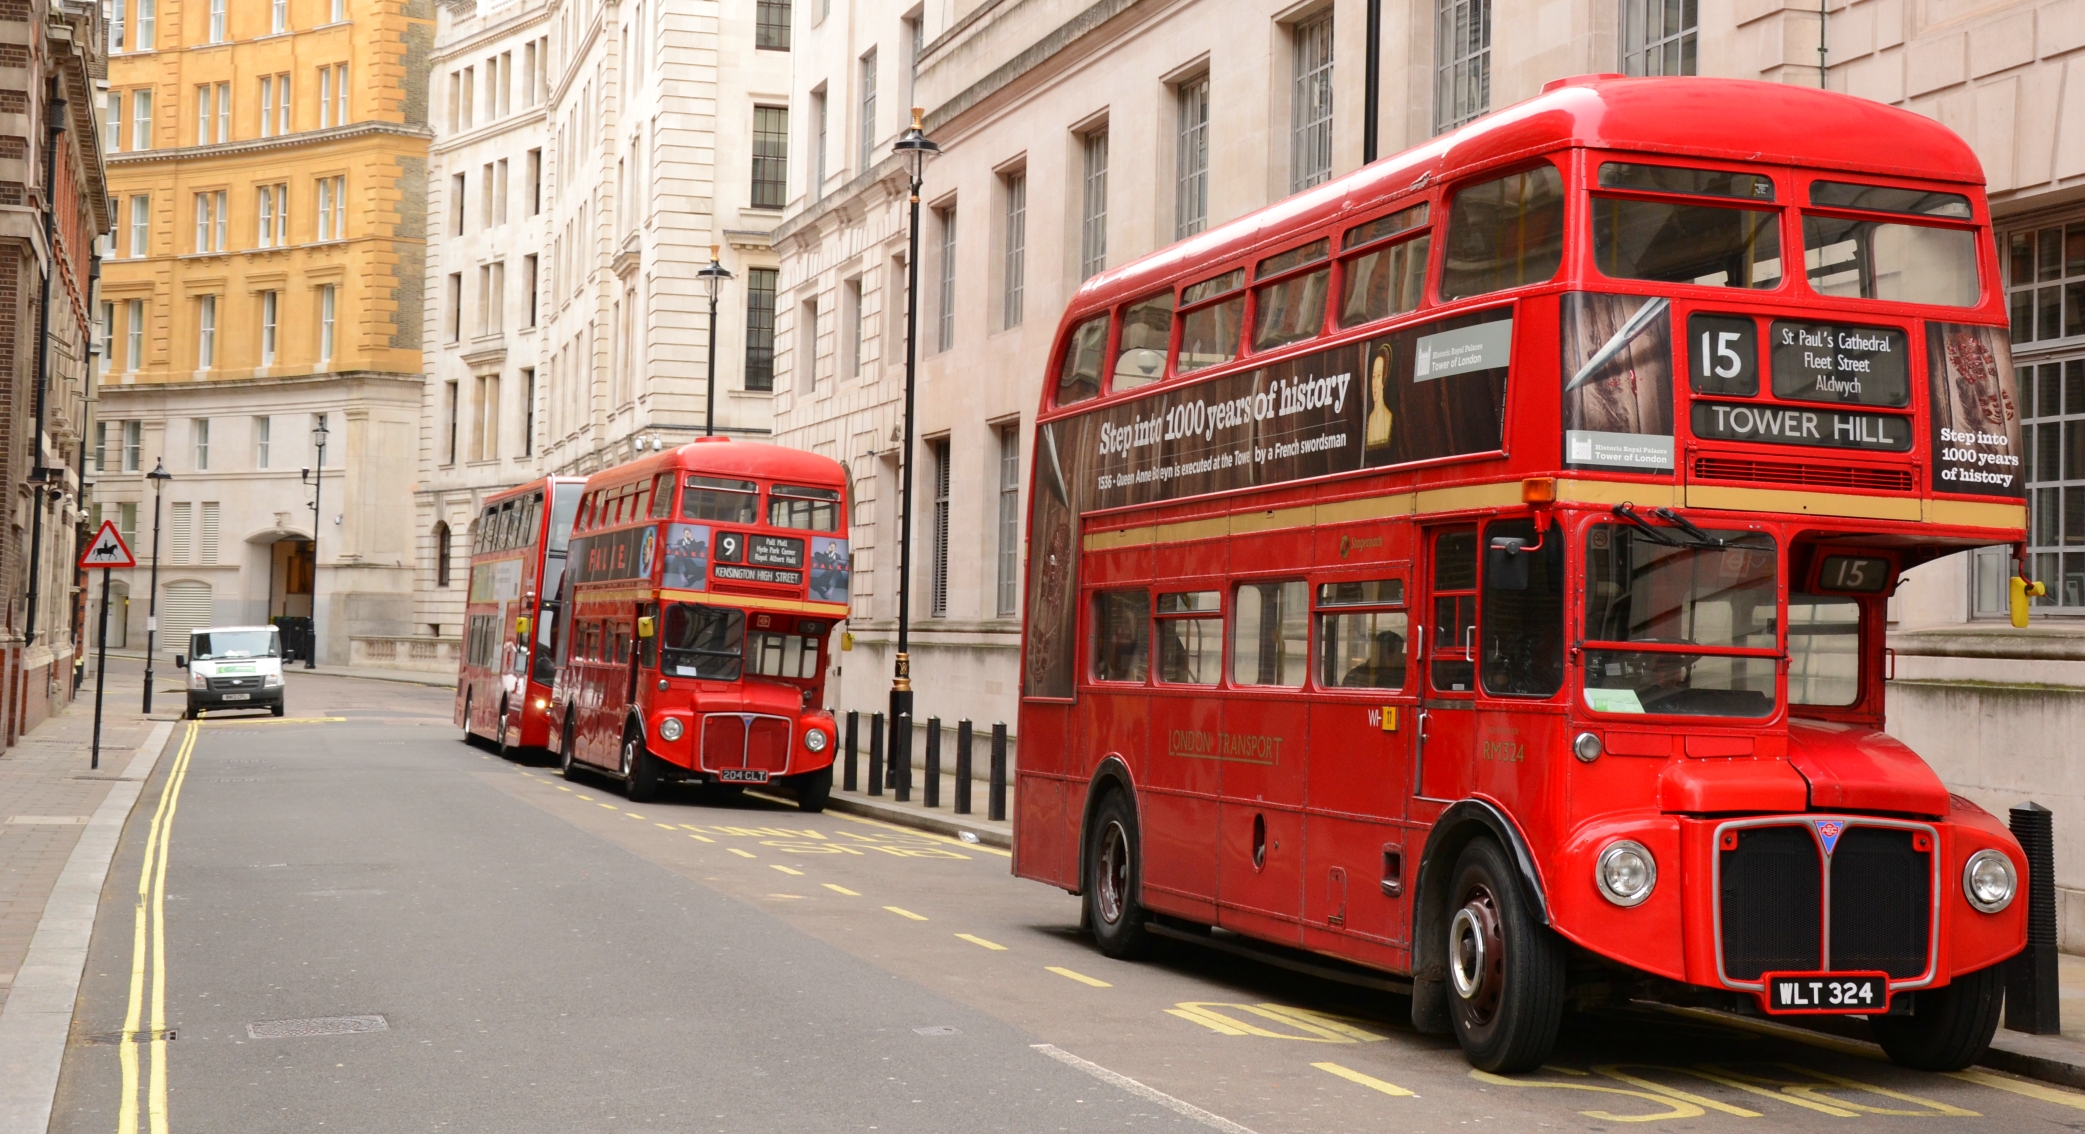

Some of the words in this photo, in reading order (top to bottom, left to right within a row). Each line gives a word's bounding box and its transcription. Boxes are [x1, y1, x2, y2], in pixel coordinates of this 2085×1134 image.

[1782, 328, 1794, 345] St
[1799, 329, 1834, 348] Paul's
[1838, 332, 1891, 353] Cathedral
[1432, 361, 1450, 372] Tower
[1450, 358, 1458, 368] of
[1458, 354, 1482, 367] London
[1701, 330, 1742, 379] 15
[1804, 352, 1832, 370] Fleet
[1837, 354, 1870, 373] Street
[1815, 375, 1861, 397] Aldwych
[1099, 422, 1132, 458] Step
[1133, 413, 1162, 447] into
[1164, 399, 1205, 441] 1000
[1205, 395, 1250, 441] years
[1253, 380, 1277, 421] of
[1278, 372, 1351, 417] history
[1712, 405, 1820, 439] TOWER
[1833, 414, 1894, 444] HILL
[1940, 427, 1976, 446] Step
[1977, 430, 2008, 446] into
[1595, 444, 1622, 452] Historic
[1623, 446, 1642, 454] Royal
[1595, 451, 1622, 461] Tower
[1624, 453, 1633, 461] of
[1635, 454, 1667, 463] London
[1941, 447, 1977, 462] 1000
[1978, 452, 2019, 466] years
[1098, 476, 1112, 490] 1536
[1116, 472, 1134, 488] Queen
[1135, 468, 1151, 484] Anne
[1151, 466, 1173, 482] Boeyn
[1174, 462, 1180, 475] is
[1182, 457, 1212, 475] executed
[1212, 455, 1220, 470] at
[1221, 452, 1232, 469] the
[1234, 450, 1252, 466] Towe
[1254, 445, 1266, 465] by
[1267, 447, 1273, 461] a
[1274, 437, 1300, 459] French
[1300, 432, 1347, 454] swordsman
[1941, 467, 1958, 481] of
[1959, 468, 2013, 488] history
[723, 537, 736, 556] 9
[756, 545, 768, 555] Hyde
[769, 546, 780, 554] Park
[781, 547, 796, 556] Corner
[777, 538, 788, 547] Mall
[754, 553, 768, 563] Royal
[769, 555, 785, 563] Albert
[785, 556, 796, 564] Hall
[715, 566, 755, 580] KENSINGTON
[757, 569, 773, 581] HIGH
[775, 572, 799, 584] STREET
[1836, 560, 1868, 587] 15
[807, 622, 815, 633] 9
[1386, 710, 1392, 725] 11
[1168, 729, 1212, 756] LONDON
[1218, 732, 1283, 766] TRANSPORT
[1483, 740, 1524, 763] RM324
[723, 770, 743, 780] 204
[744, 771, 765, 780] CLT
[1820, 826, 1839, 834] AEC
[1779, 982, 1823, 1004] WLT
[1828, 982, 1874, 1004] 324
